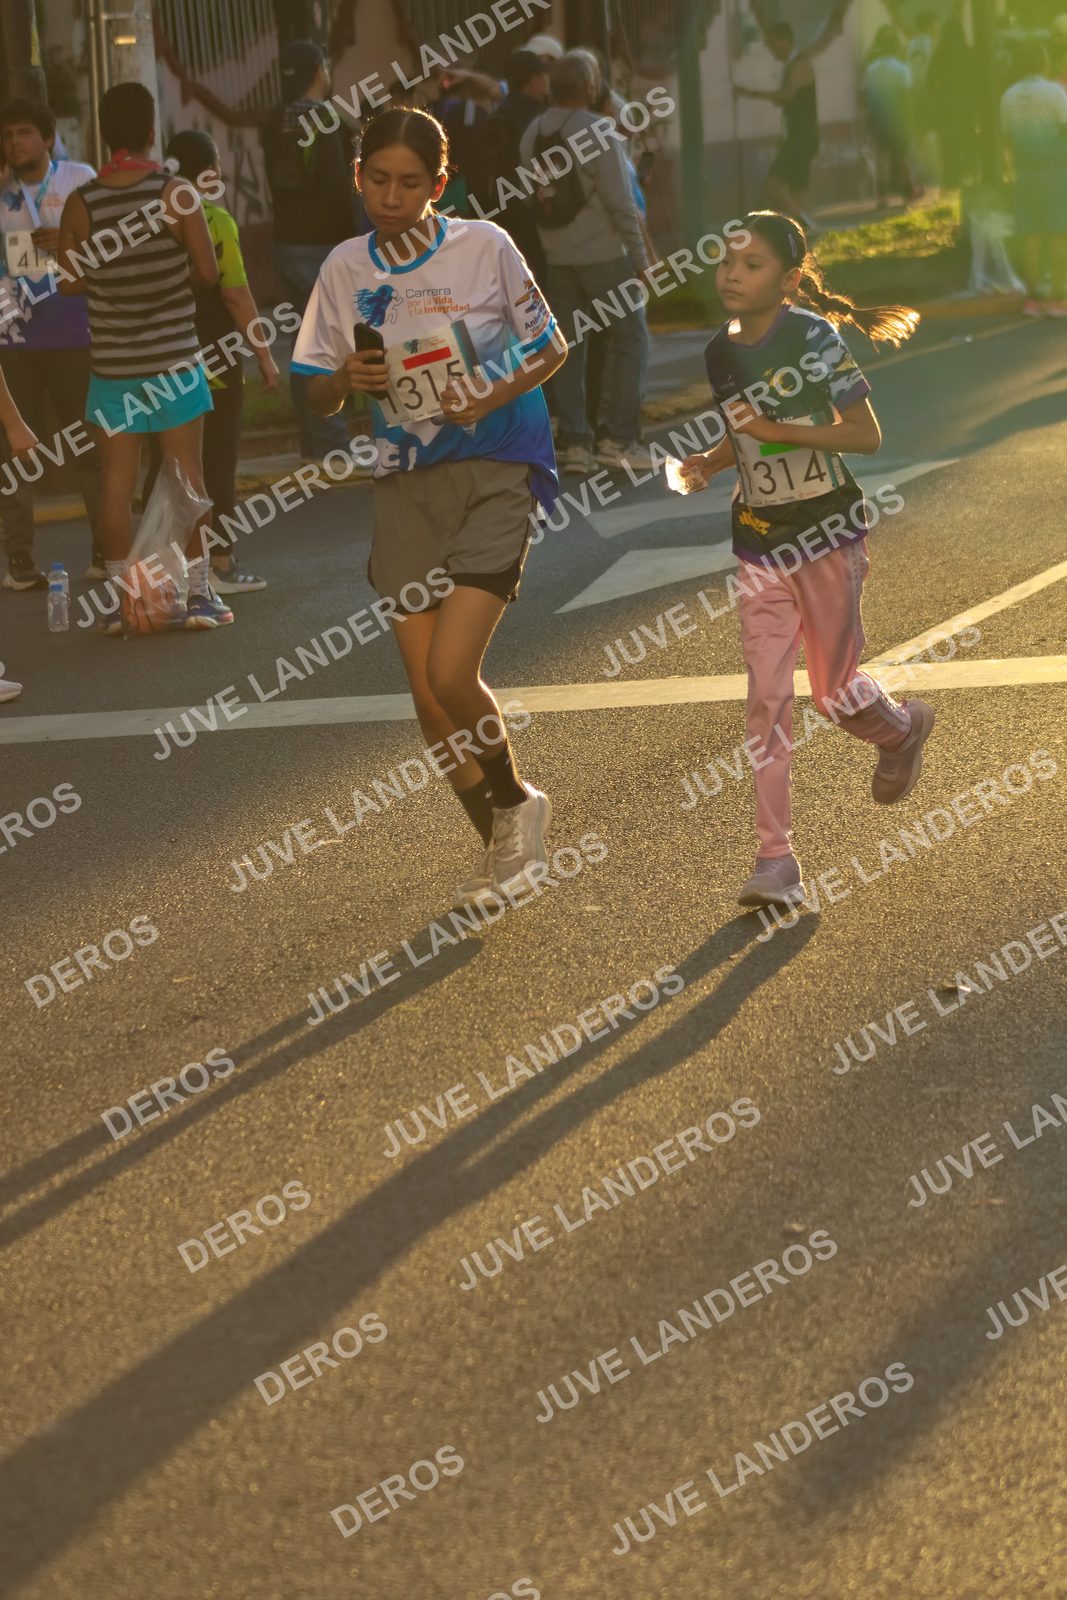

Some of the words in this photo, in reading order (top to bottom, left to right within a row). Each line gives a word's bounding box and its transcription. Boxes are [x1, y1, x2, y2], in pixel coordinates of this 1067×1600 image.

[405, 287, 451, 299] Carrera
[433, 296, 453, 305] Vida
[424, 303, 471, 314] Integridad
[741, 450, 826, 497] 1314
